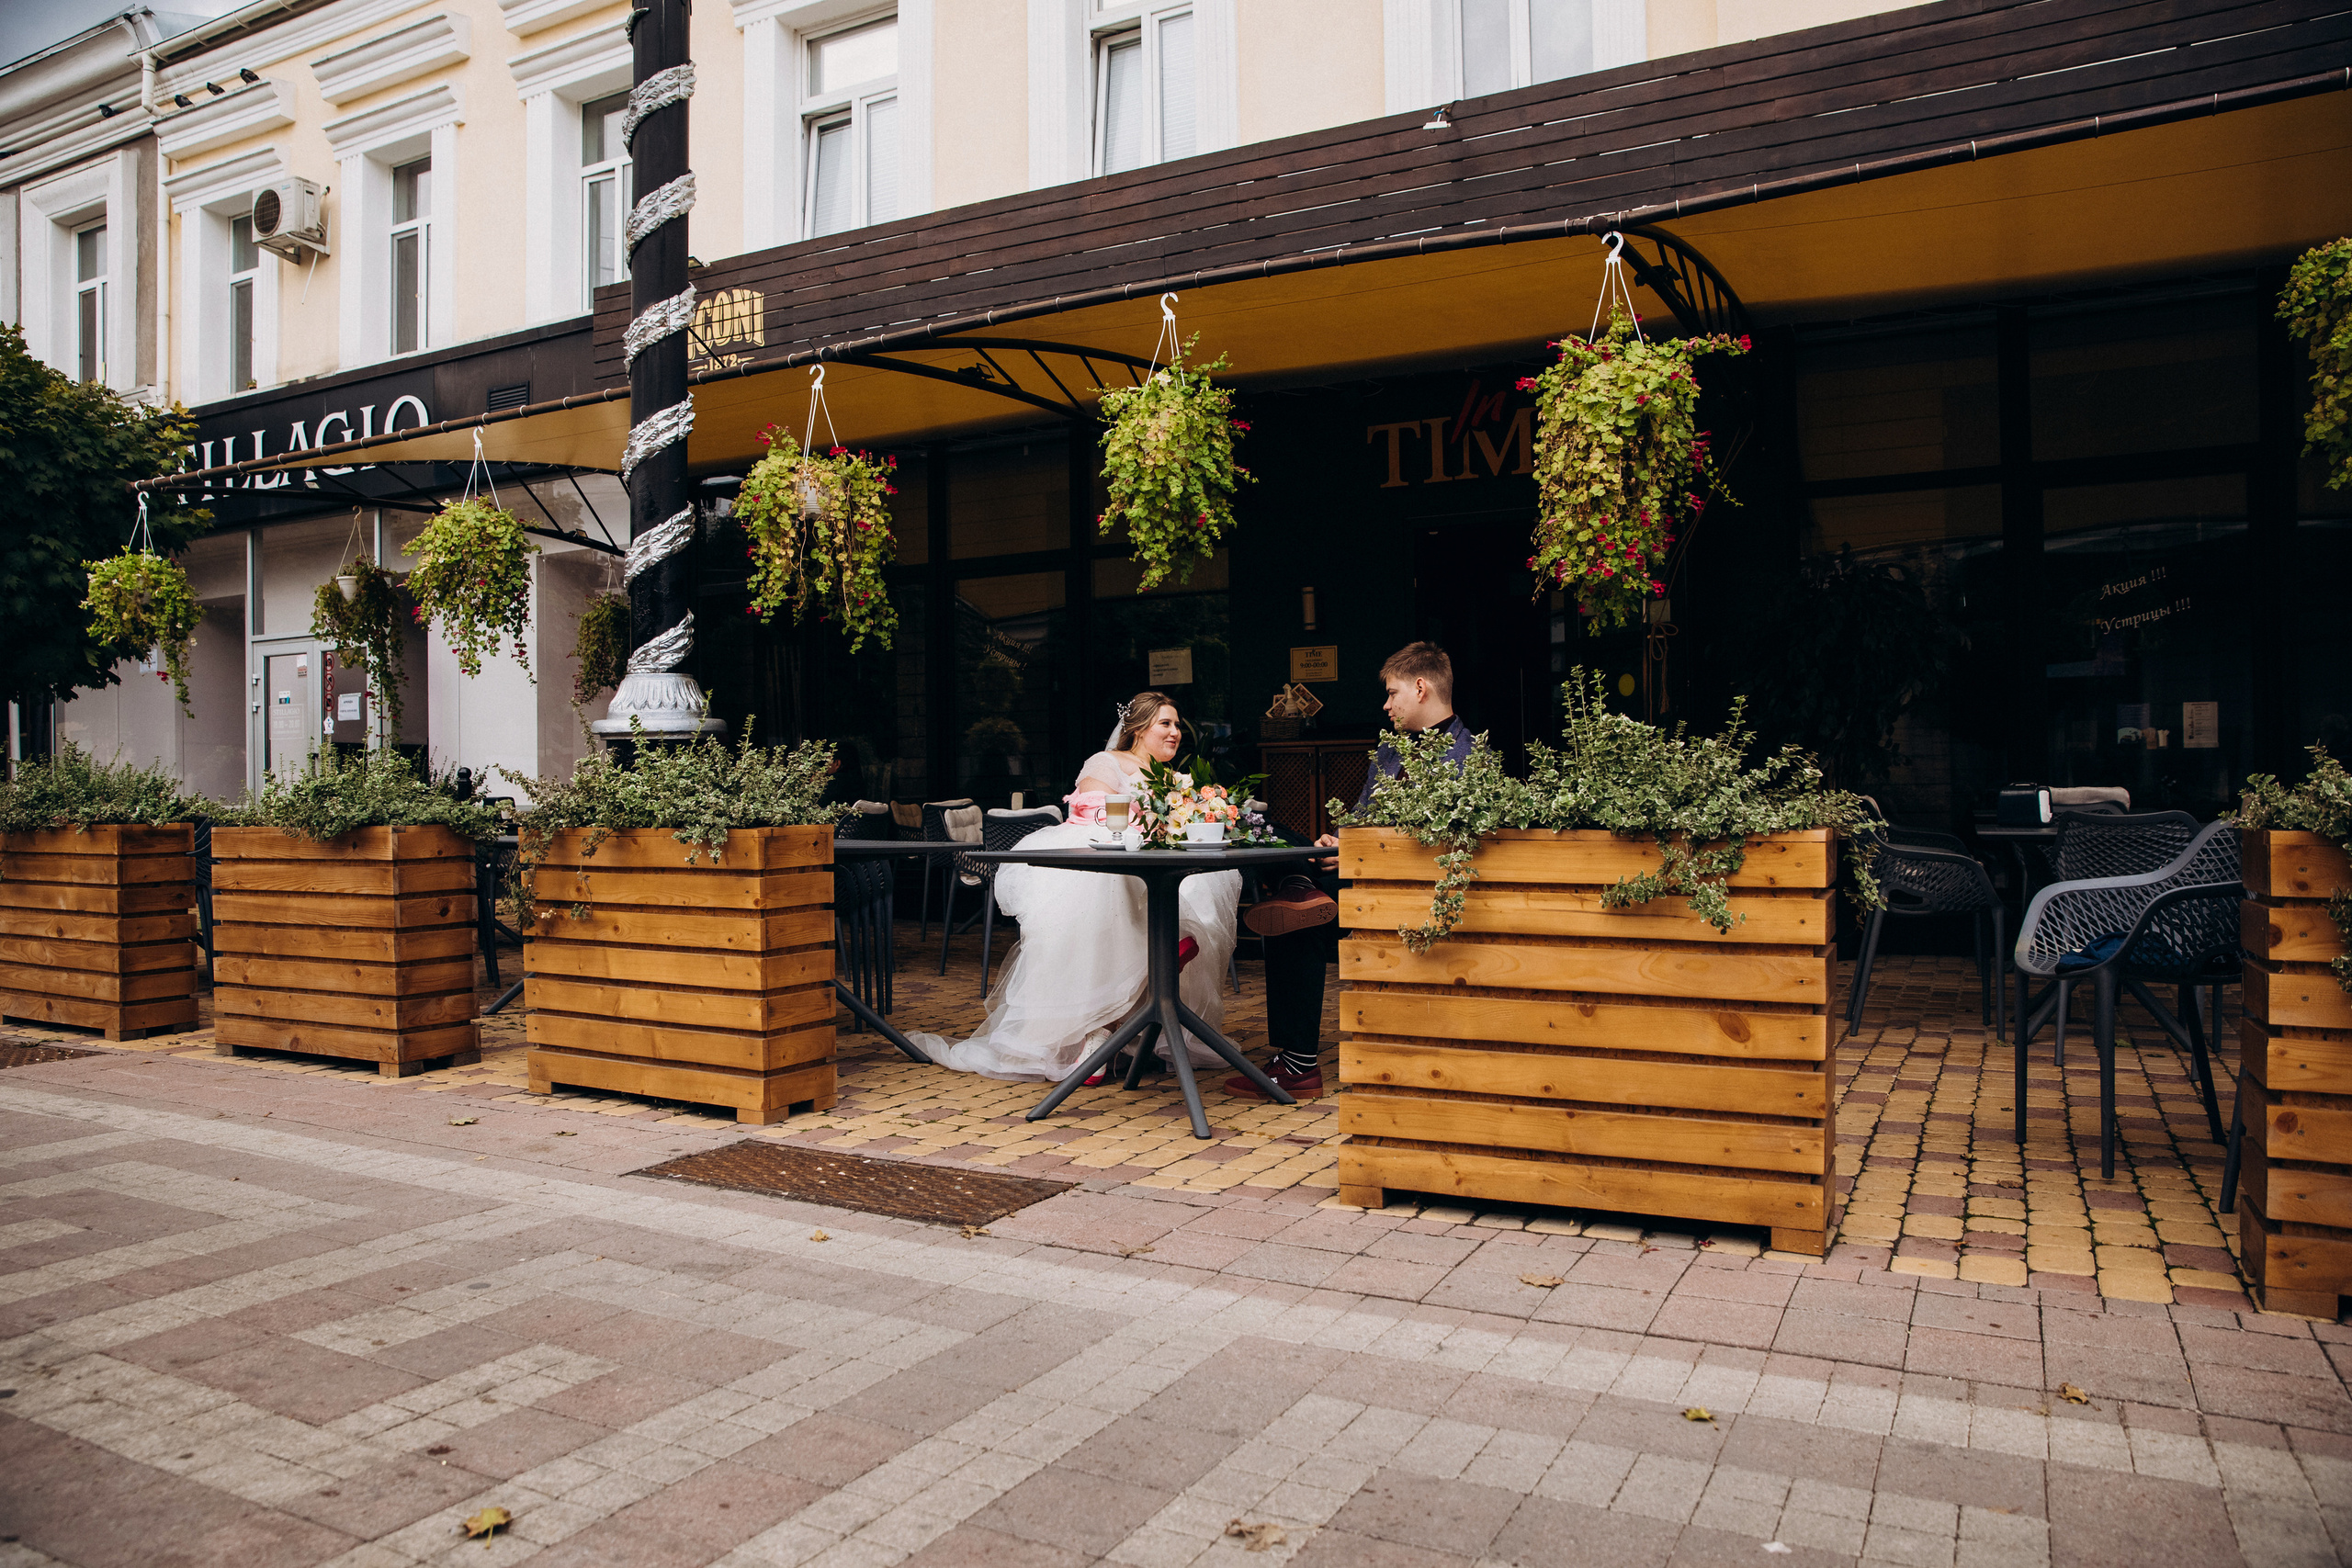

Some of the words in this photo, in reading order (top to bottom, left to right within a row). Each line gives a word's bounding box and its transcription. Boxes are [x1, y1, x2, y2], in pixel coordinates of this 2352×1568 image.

[1450, 378, 1507, 445] In
[166, 395, 428, 505] ILLAGIO
[1367, 407, 1538, 488] TIM
[2099, 576, 2147, 601] Акция
[2151, 566, 2166, 581] !!!
[2100, 606, 2172, 635] Устрицы
[2176, 596, 2191, 612] !!!
[983, 644, 1021, 668] Устрицы
[993, 631, 1021, 649] Акция
